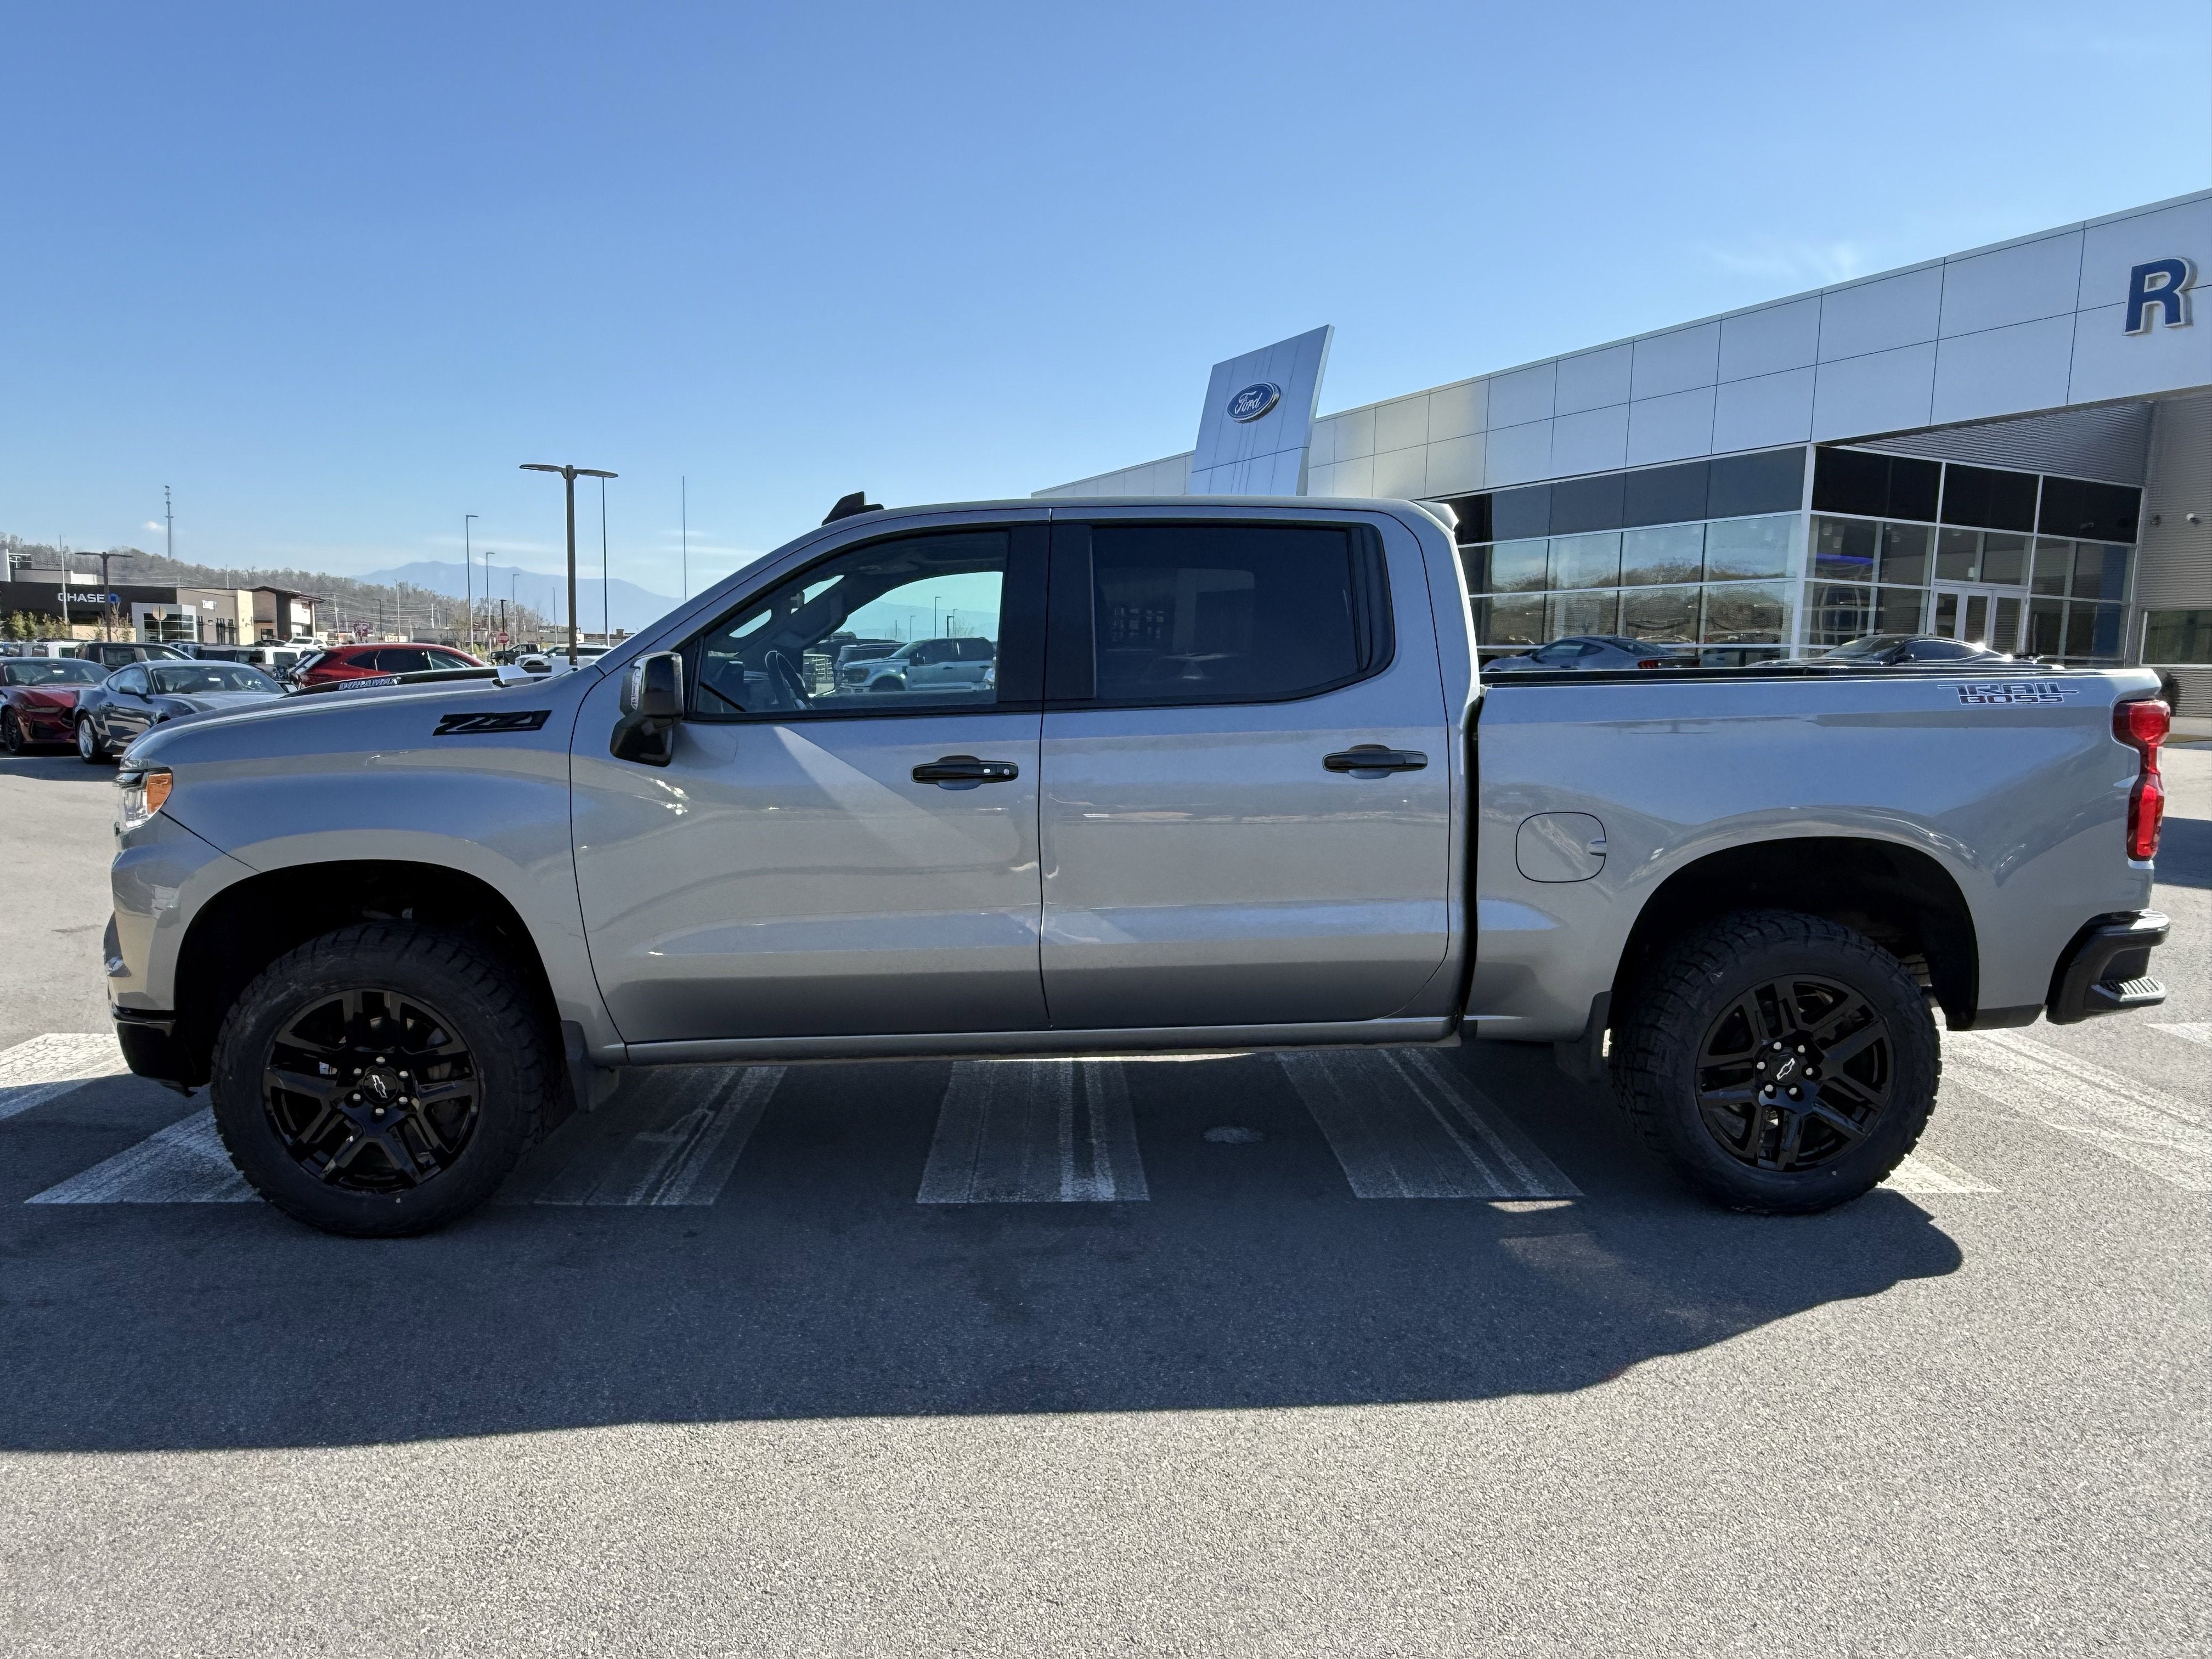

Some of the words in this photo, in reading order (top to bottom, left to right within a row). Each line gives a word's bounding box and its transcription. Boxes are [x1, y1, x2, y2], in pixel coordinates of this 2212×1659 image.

[2123, 257, 2196, 336] R
[1234, 390, 1263, 414] Ford
[58, 592, 105, 603] CHASE
[1937, 682, 2079, 694] TRAIL
[1959, 694, 2064, 704] BOSS
